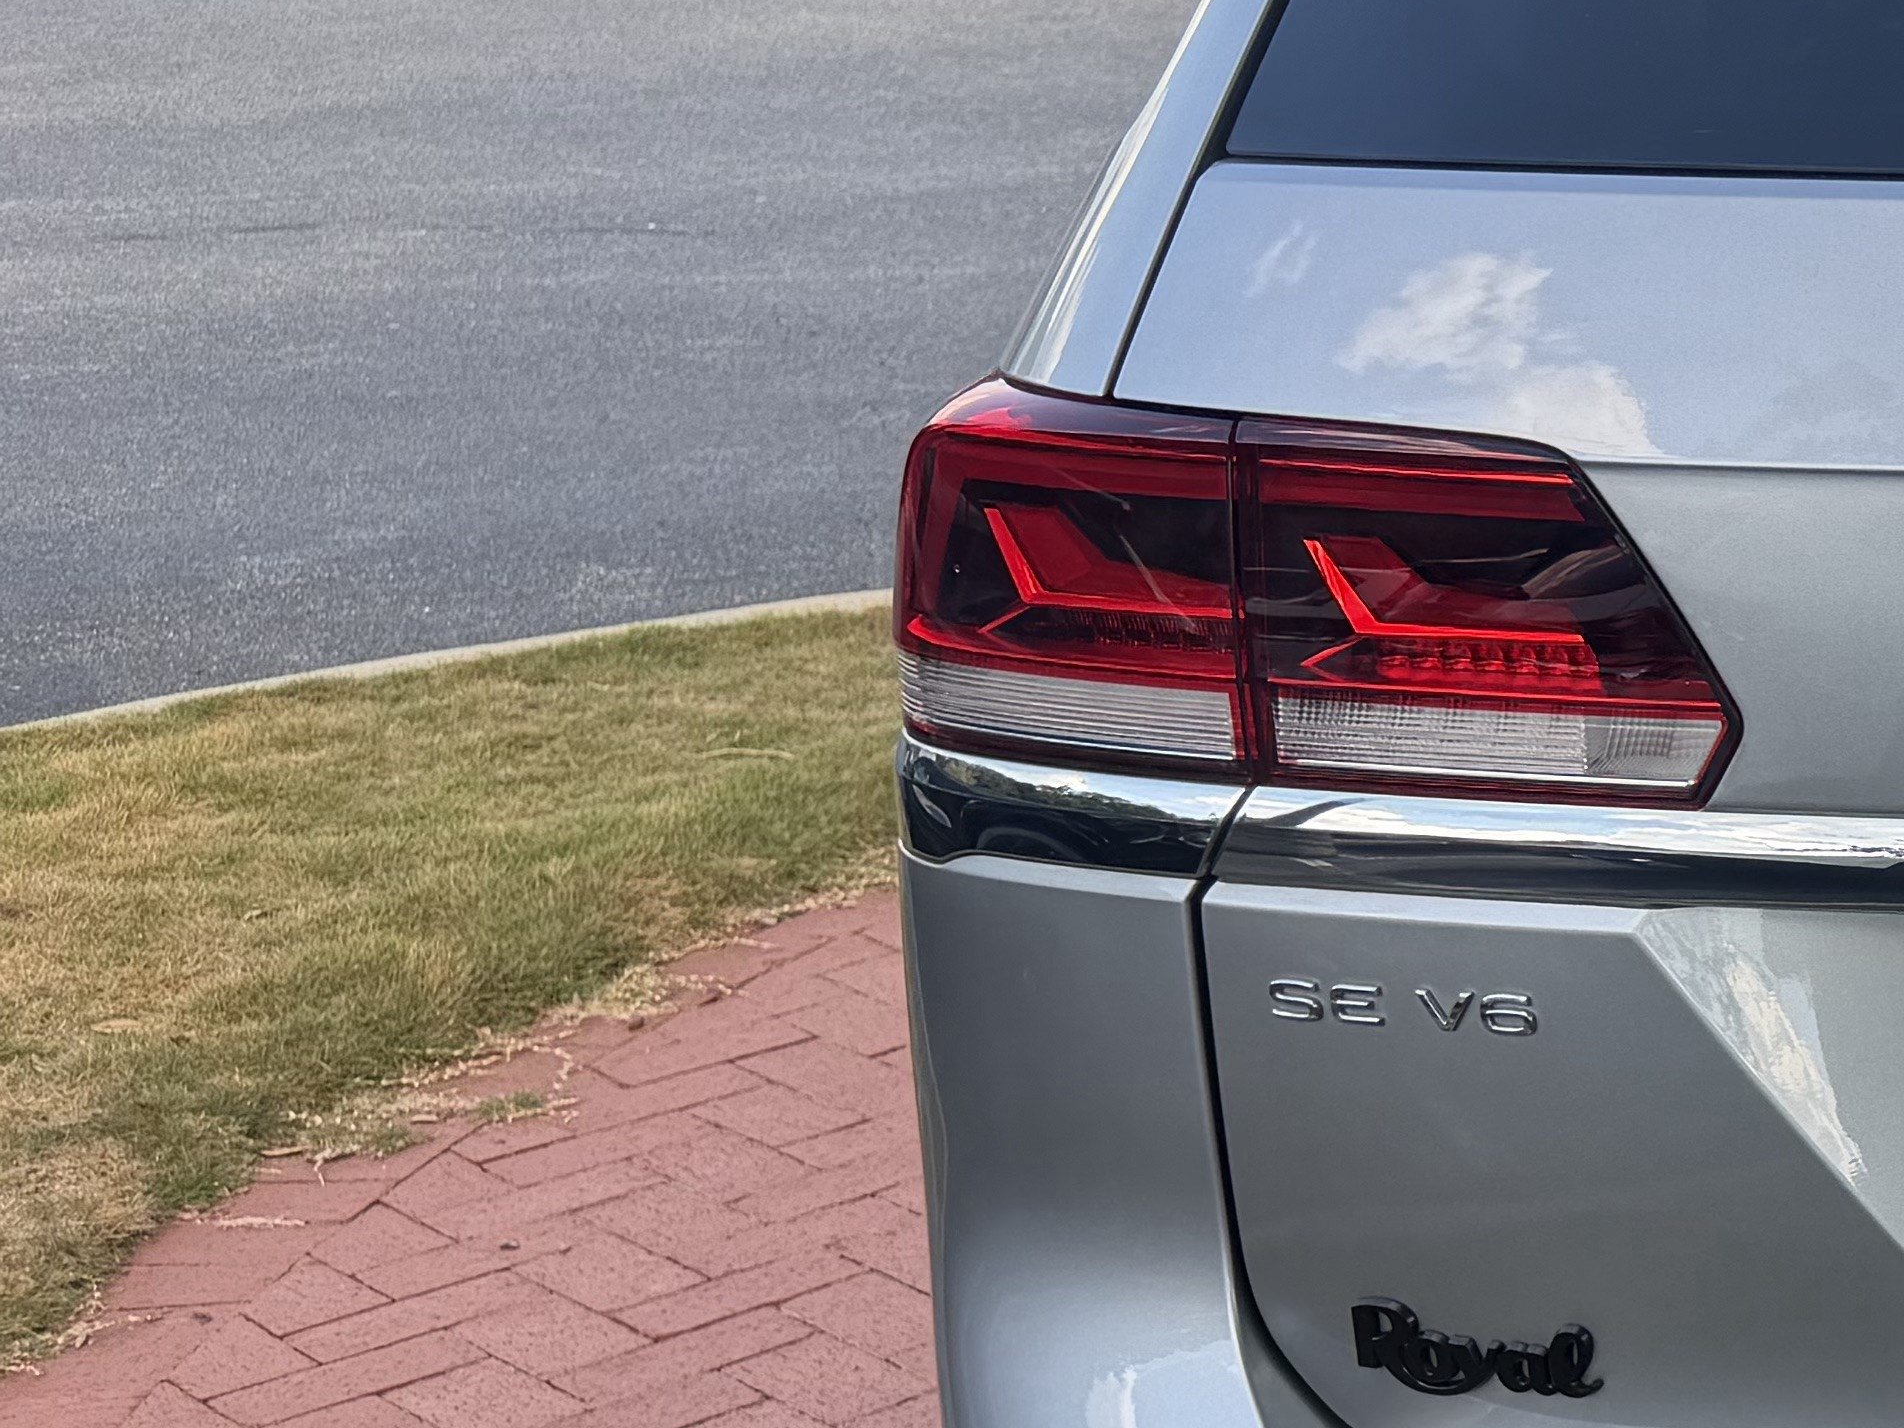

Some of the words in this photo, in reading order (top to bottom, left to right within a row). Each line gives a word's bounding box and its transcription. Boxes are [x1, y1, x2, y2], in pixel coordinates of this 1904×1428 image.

[1269, 979, 1386, 1027] SE
[1414, 988, 1539, 1037] V6
[1351, 1295, 1605, 1399] Royal
